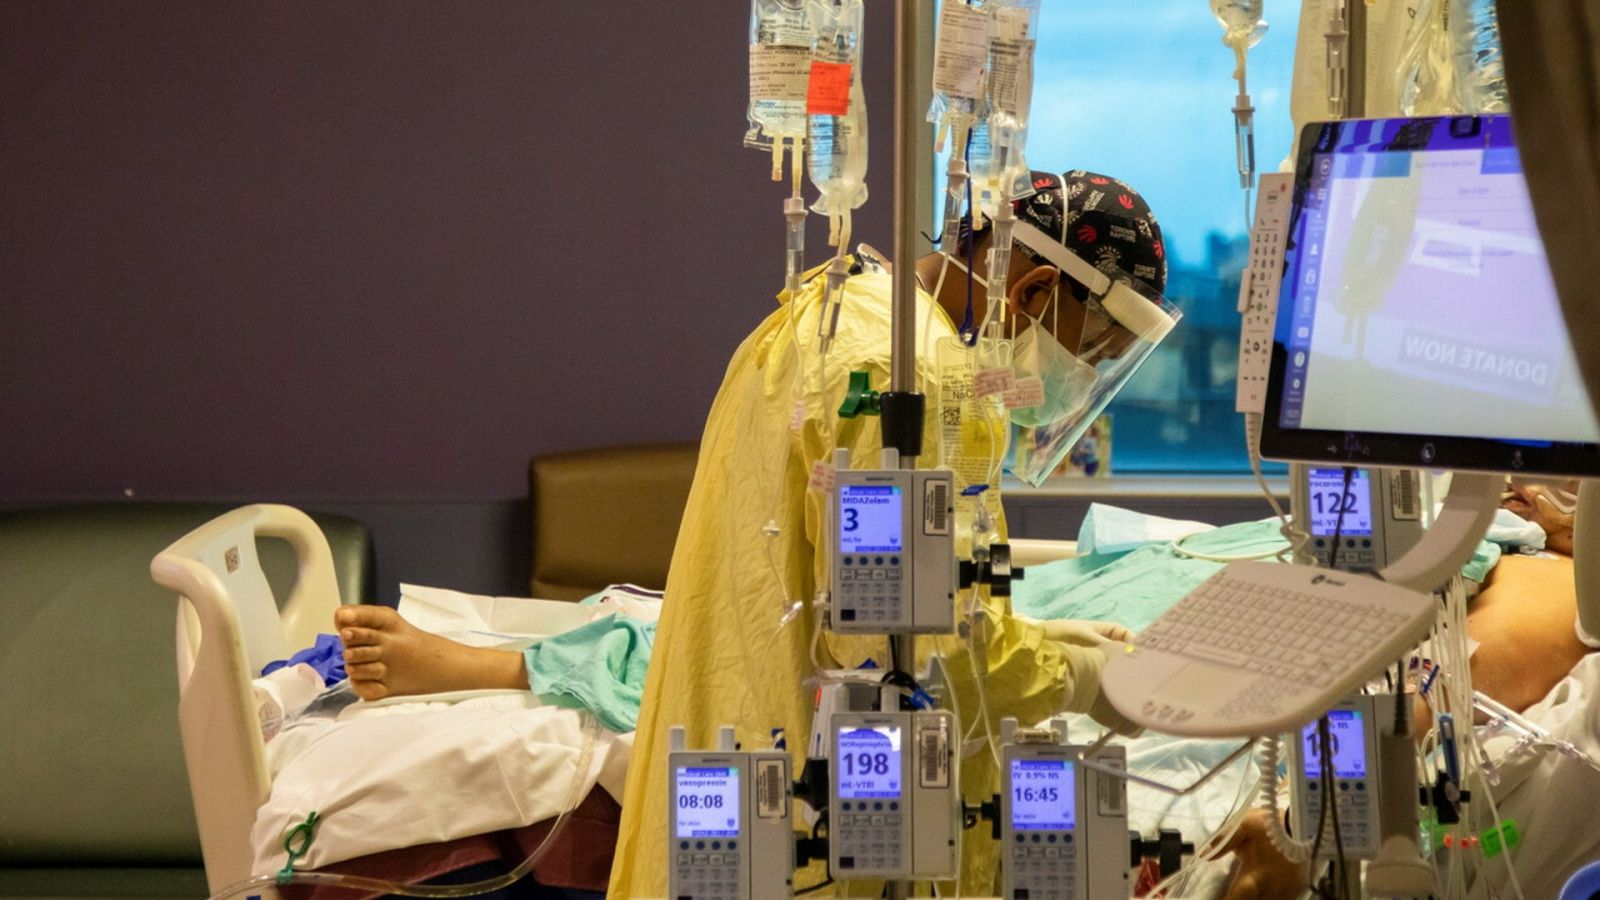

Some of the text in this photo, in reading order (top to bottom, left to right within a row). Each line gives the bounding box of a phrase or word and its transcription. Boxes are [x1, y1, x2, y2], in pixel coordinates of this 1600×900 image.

[842, 497, 889, 505] MIDAZolam
[1312, 492, 1359, 514] 122
[843, 508, 859, 532] 3
[842, 753, 890, 776] 198
[1013, 772, 1022, 780] IV
[1048, 772, 1060, 780] NS
[679, 780, 728, 788] vasopressin
[1015, 787, 1059, 802] 16:45
[679, 795, 724, 809] 08:08
